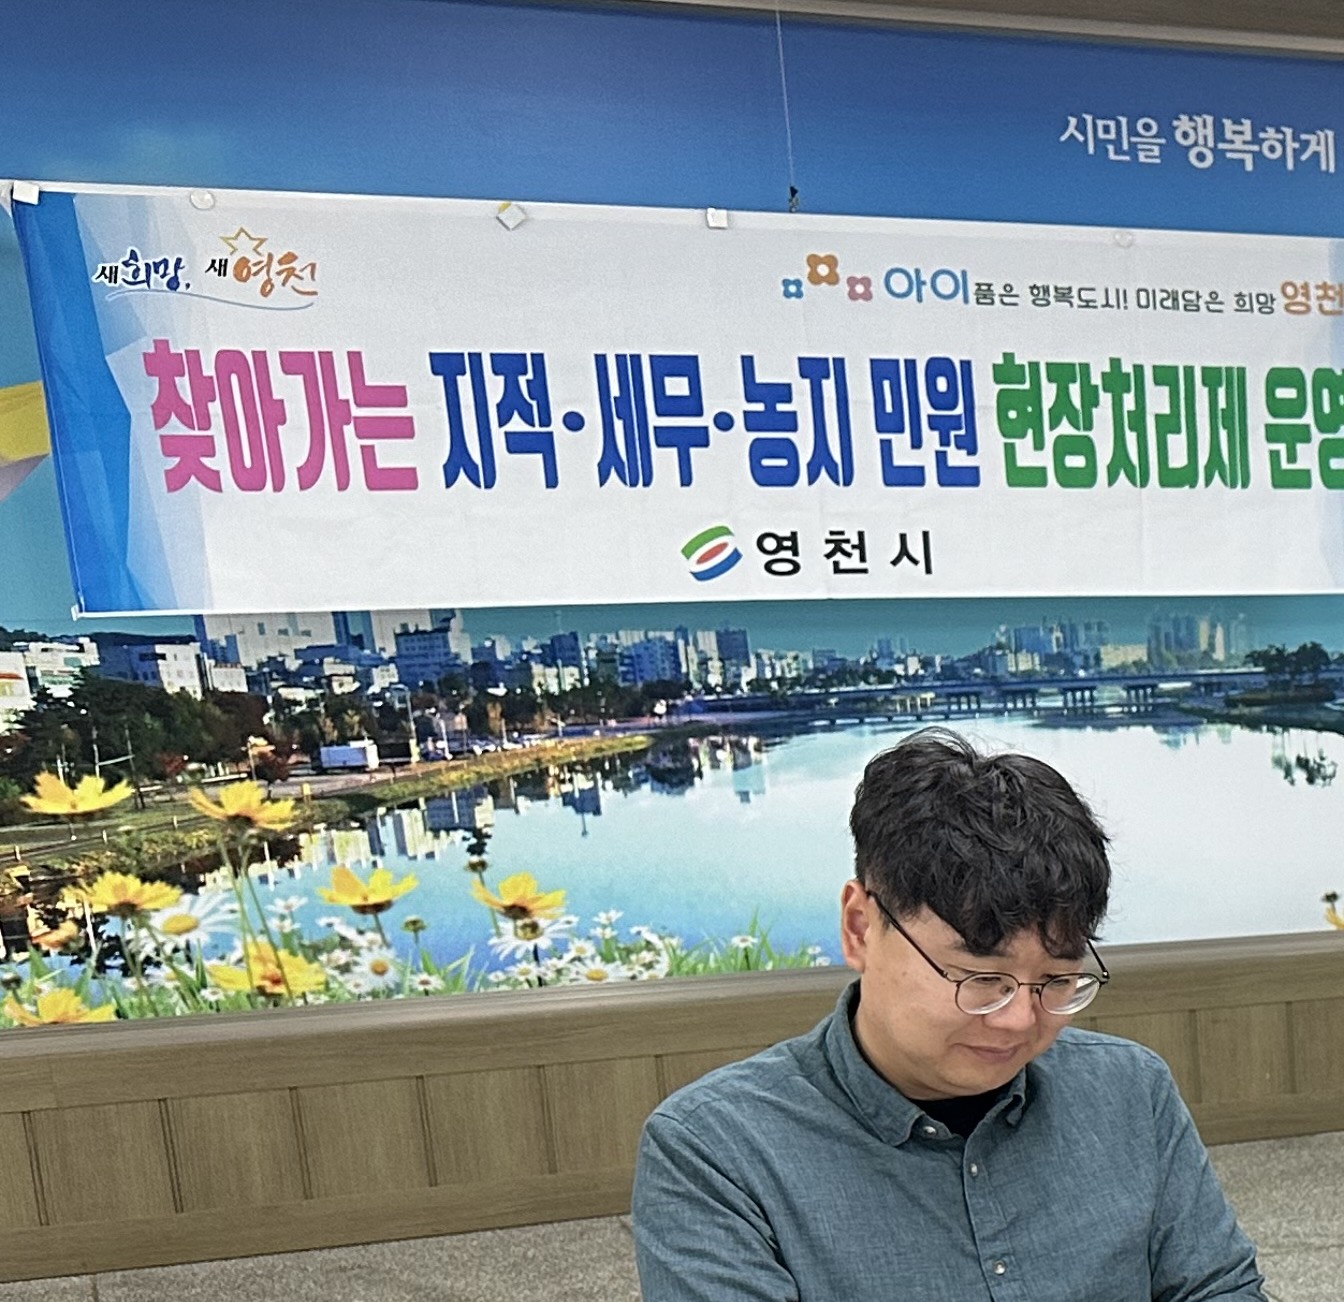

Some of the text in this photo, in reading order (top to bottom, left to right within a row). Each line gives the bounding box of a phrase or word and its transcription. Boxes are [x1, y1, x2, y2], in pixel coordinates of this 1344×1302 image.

[1059, 112, 1166, 164] 시민을
[1172, 112, 1335, 173] 행복하게
[1029, 282, 1129, 312] 행복도시!
[1135, 286, 1224, 315] 미래담은
[1233, 290, 1276, 316] 희망
[142, 338, 419, 494] 찾아가는
[870, 355, 981, 490] 민원
[992, 350, 1251, 490] 현장처리제
